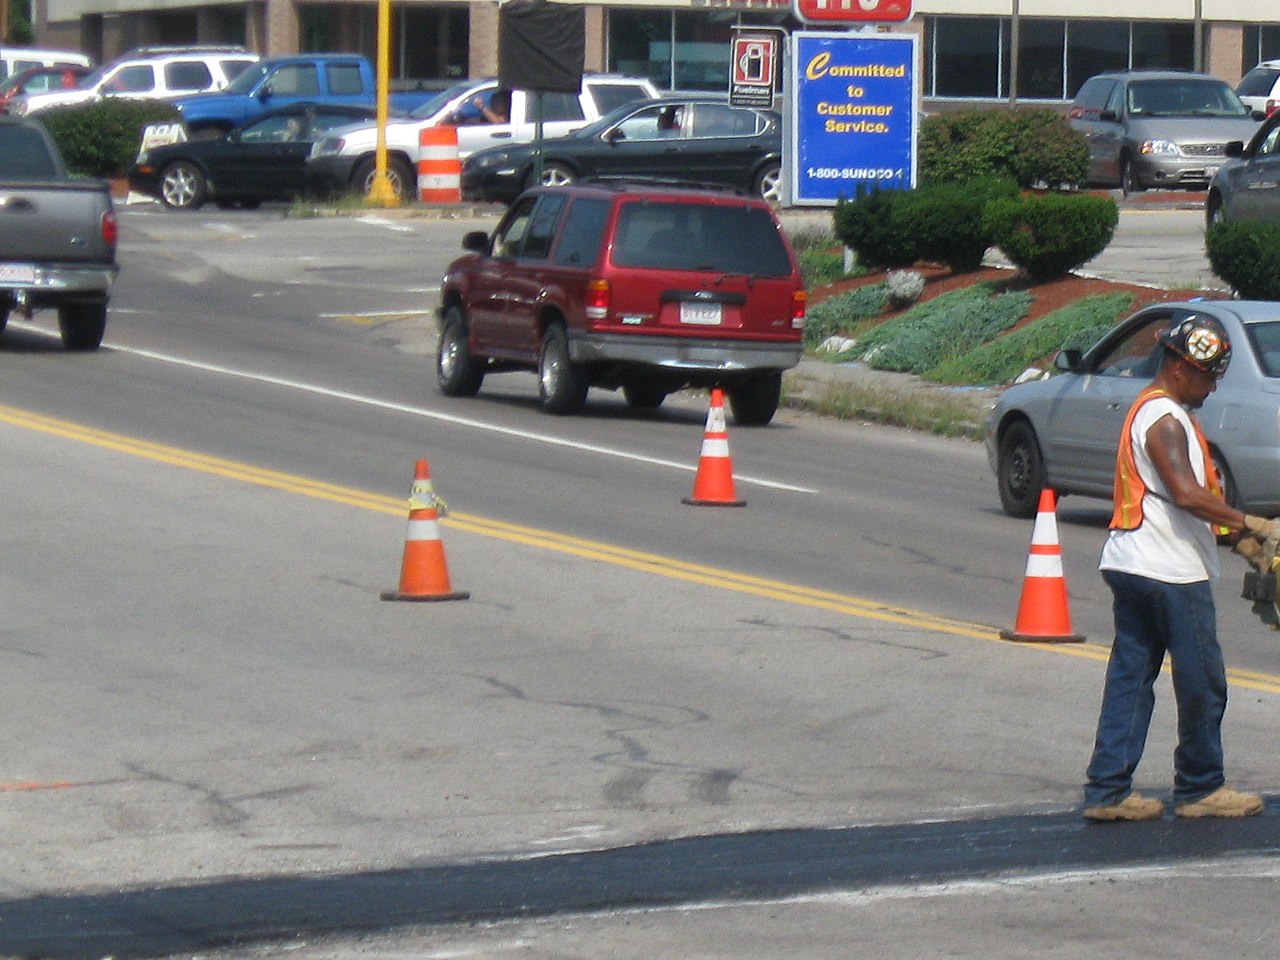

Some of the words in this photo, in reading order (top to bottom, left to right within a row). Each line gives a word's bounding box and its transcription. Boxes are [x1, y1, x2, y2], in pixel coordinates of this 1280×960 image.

[806, 52, 905, 80] Committed
[734, 84, 770, 94] Fuelman
[847, 85, 864, 98] to
[816, 102, 893, 116] Customer
[824, 119, 890, 133] Service.
